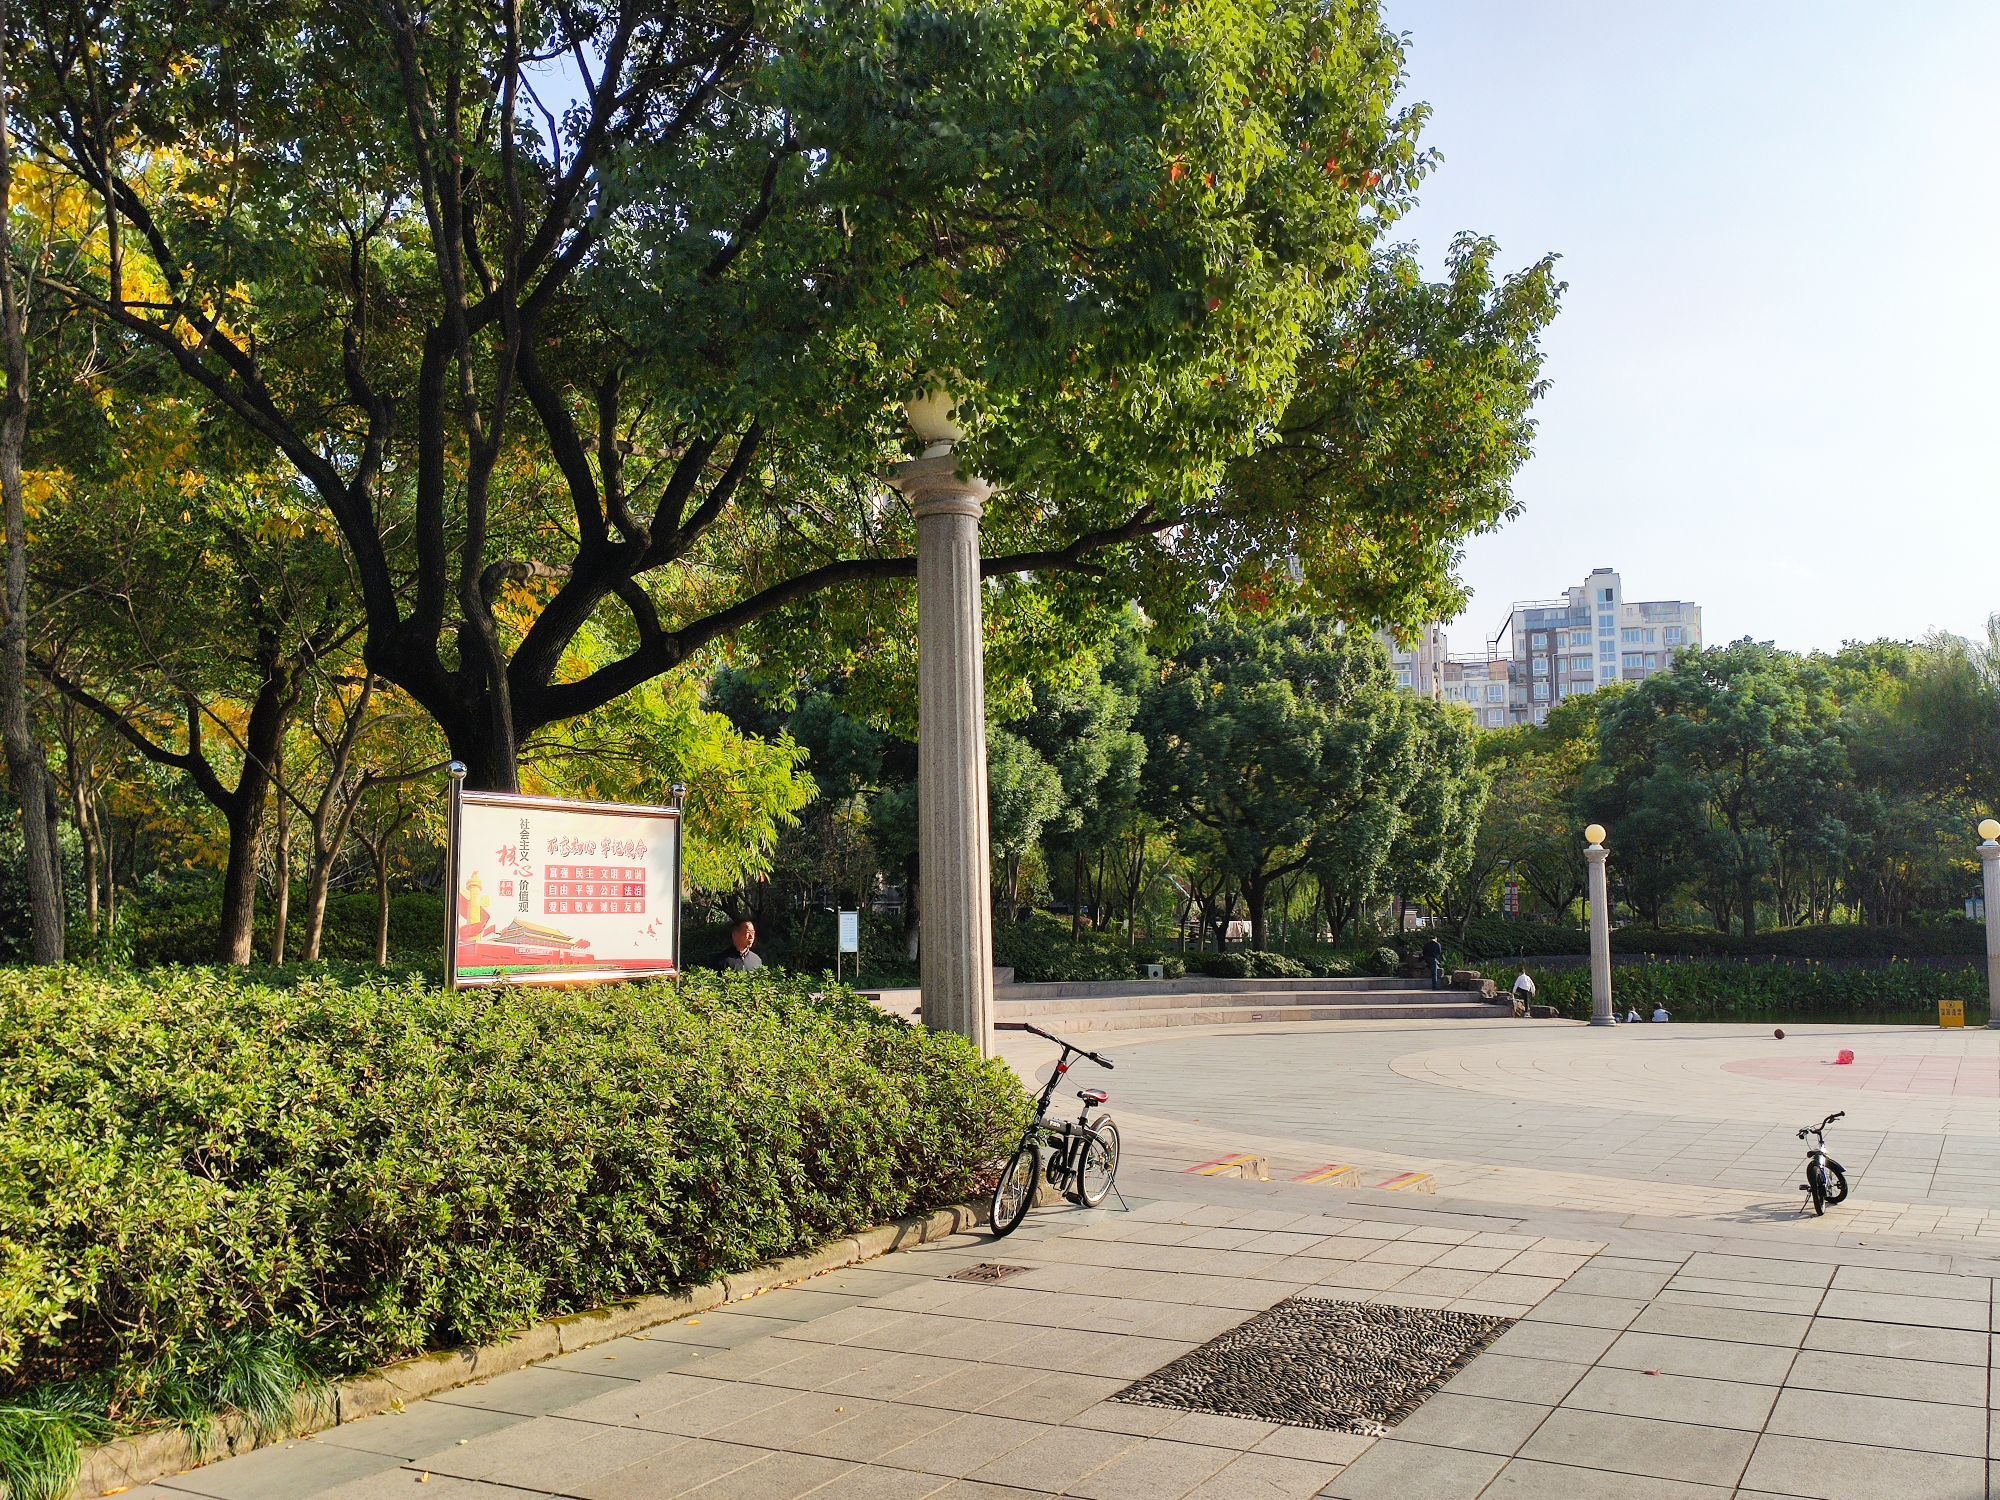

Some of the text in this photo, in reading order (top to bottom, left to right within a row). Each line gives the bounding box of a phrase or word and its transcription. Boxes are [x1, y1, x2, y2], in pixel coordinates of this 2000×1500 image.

[519, 818, 530, 862] 社会主义
[547, 835, 648, 861] 不忘初心 牢记使命
[549, 867, 642, 880] 富强 民主 文明 和谐
[518, 879, 529, 913] 价值观
[549, 884, 642, 896] 自由 平等 公正 法治
[548, 901, 642, 912] 爱国 敬业 诚信 友善
